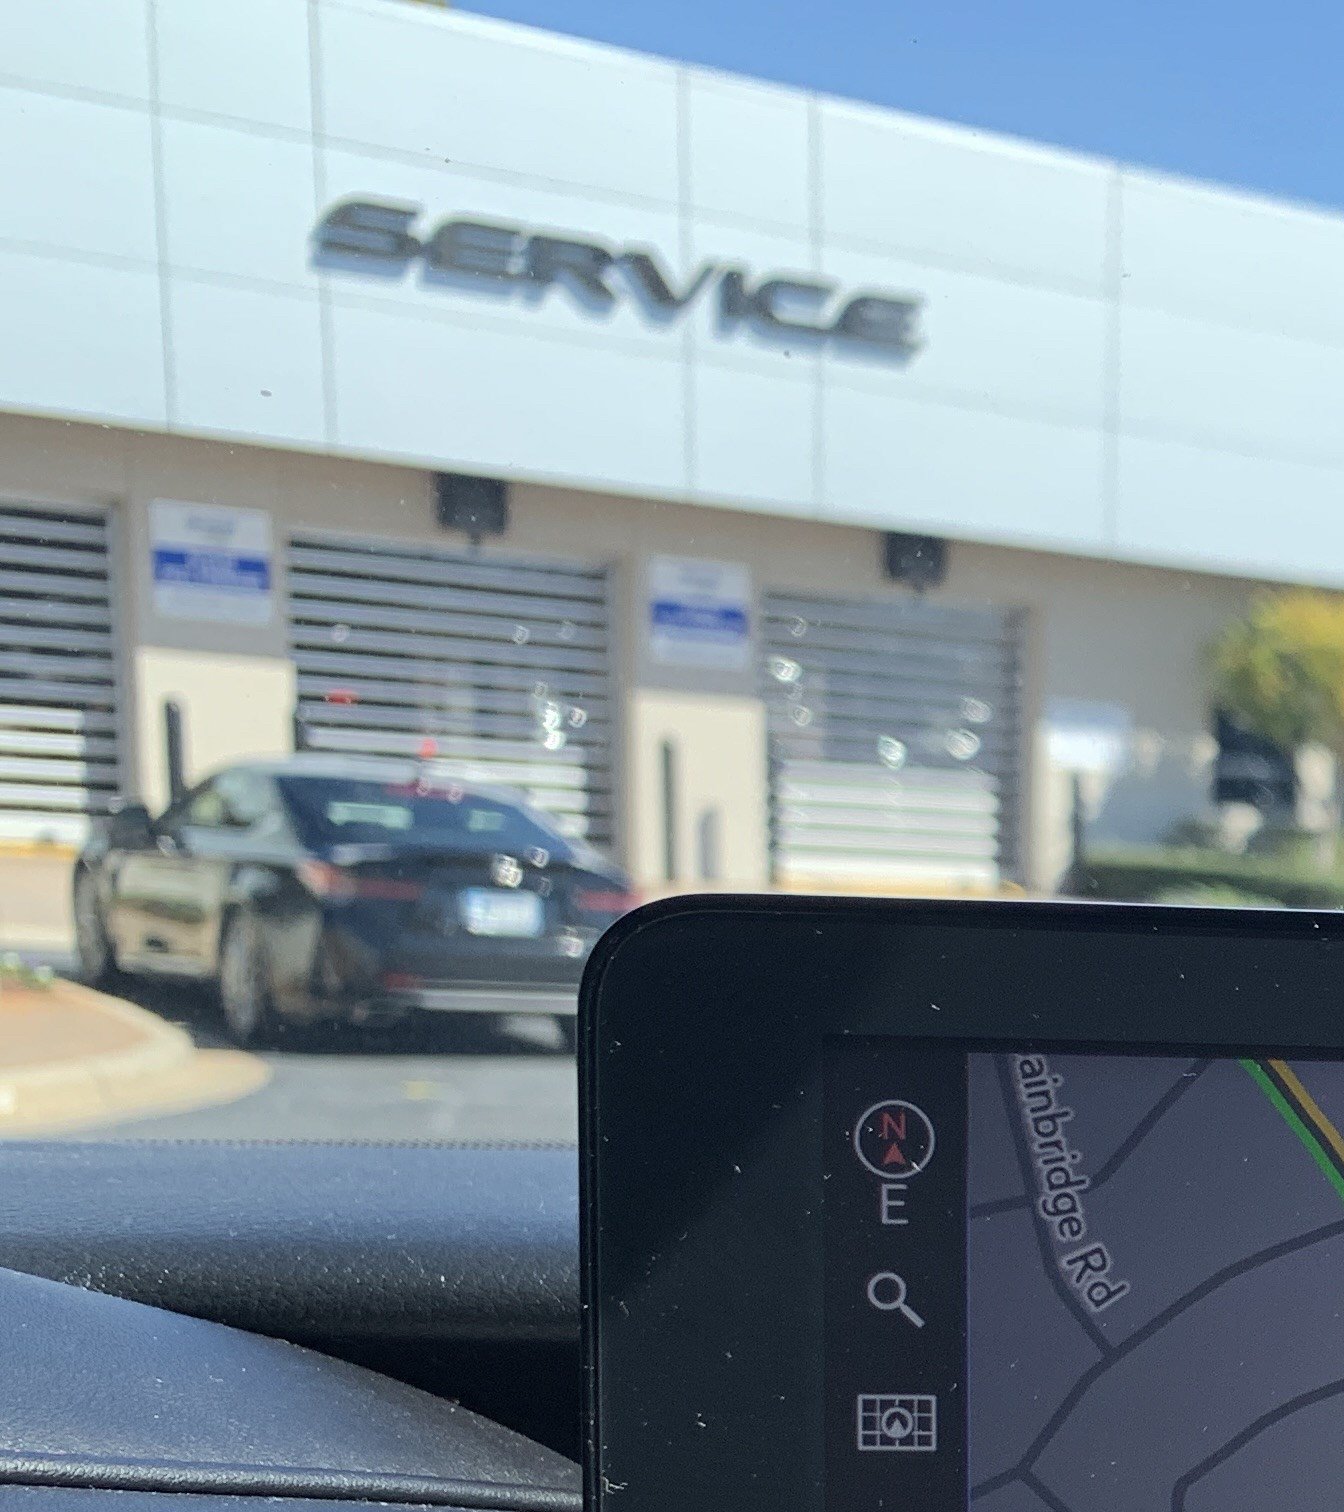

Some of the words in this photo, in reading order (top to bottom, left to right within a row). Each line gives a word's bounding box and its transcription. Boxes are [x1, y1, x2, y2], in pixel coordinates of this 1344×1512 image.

[310, 198, 922, 360] SERVICE
[881, 1110, 907, 1140] N
[881, 1183, 909, 1224] E
[1066, 1247, 1126, 1309] Rd
